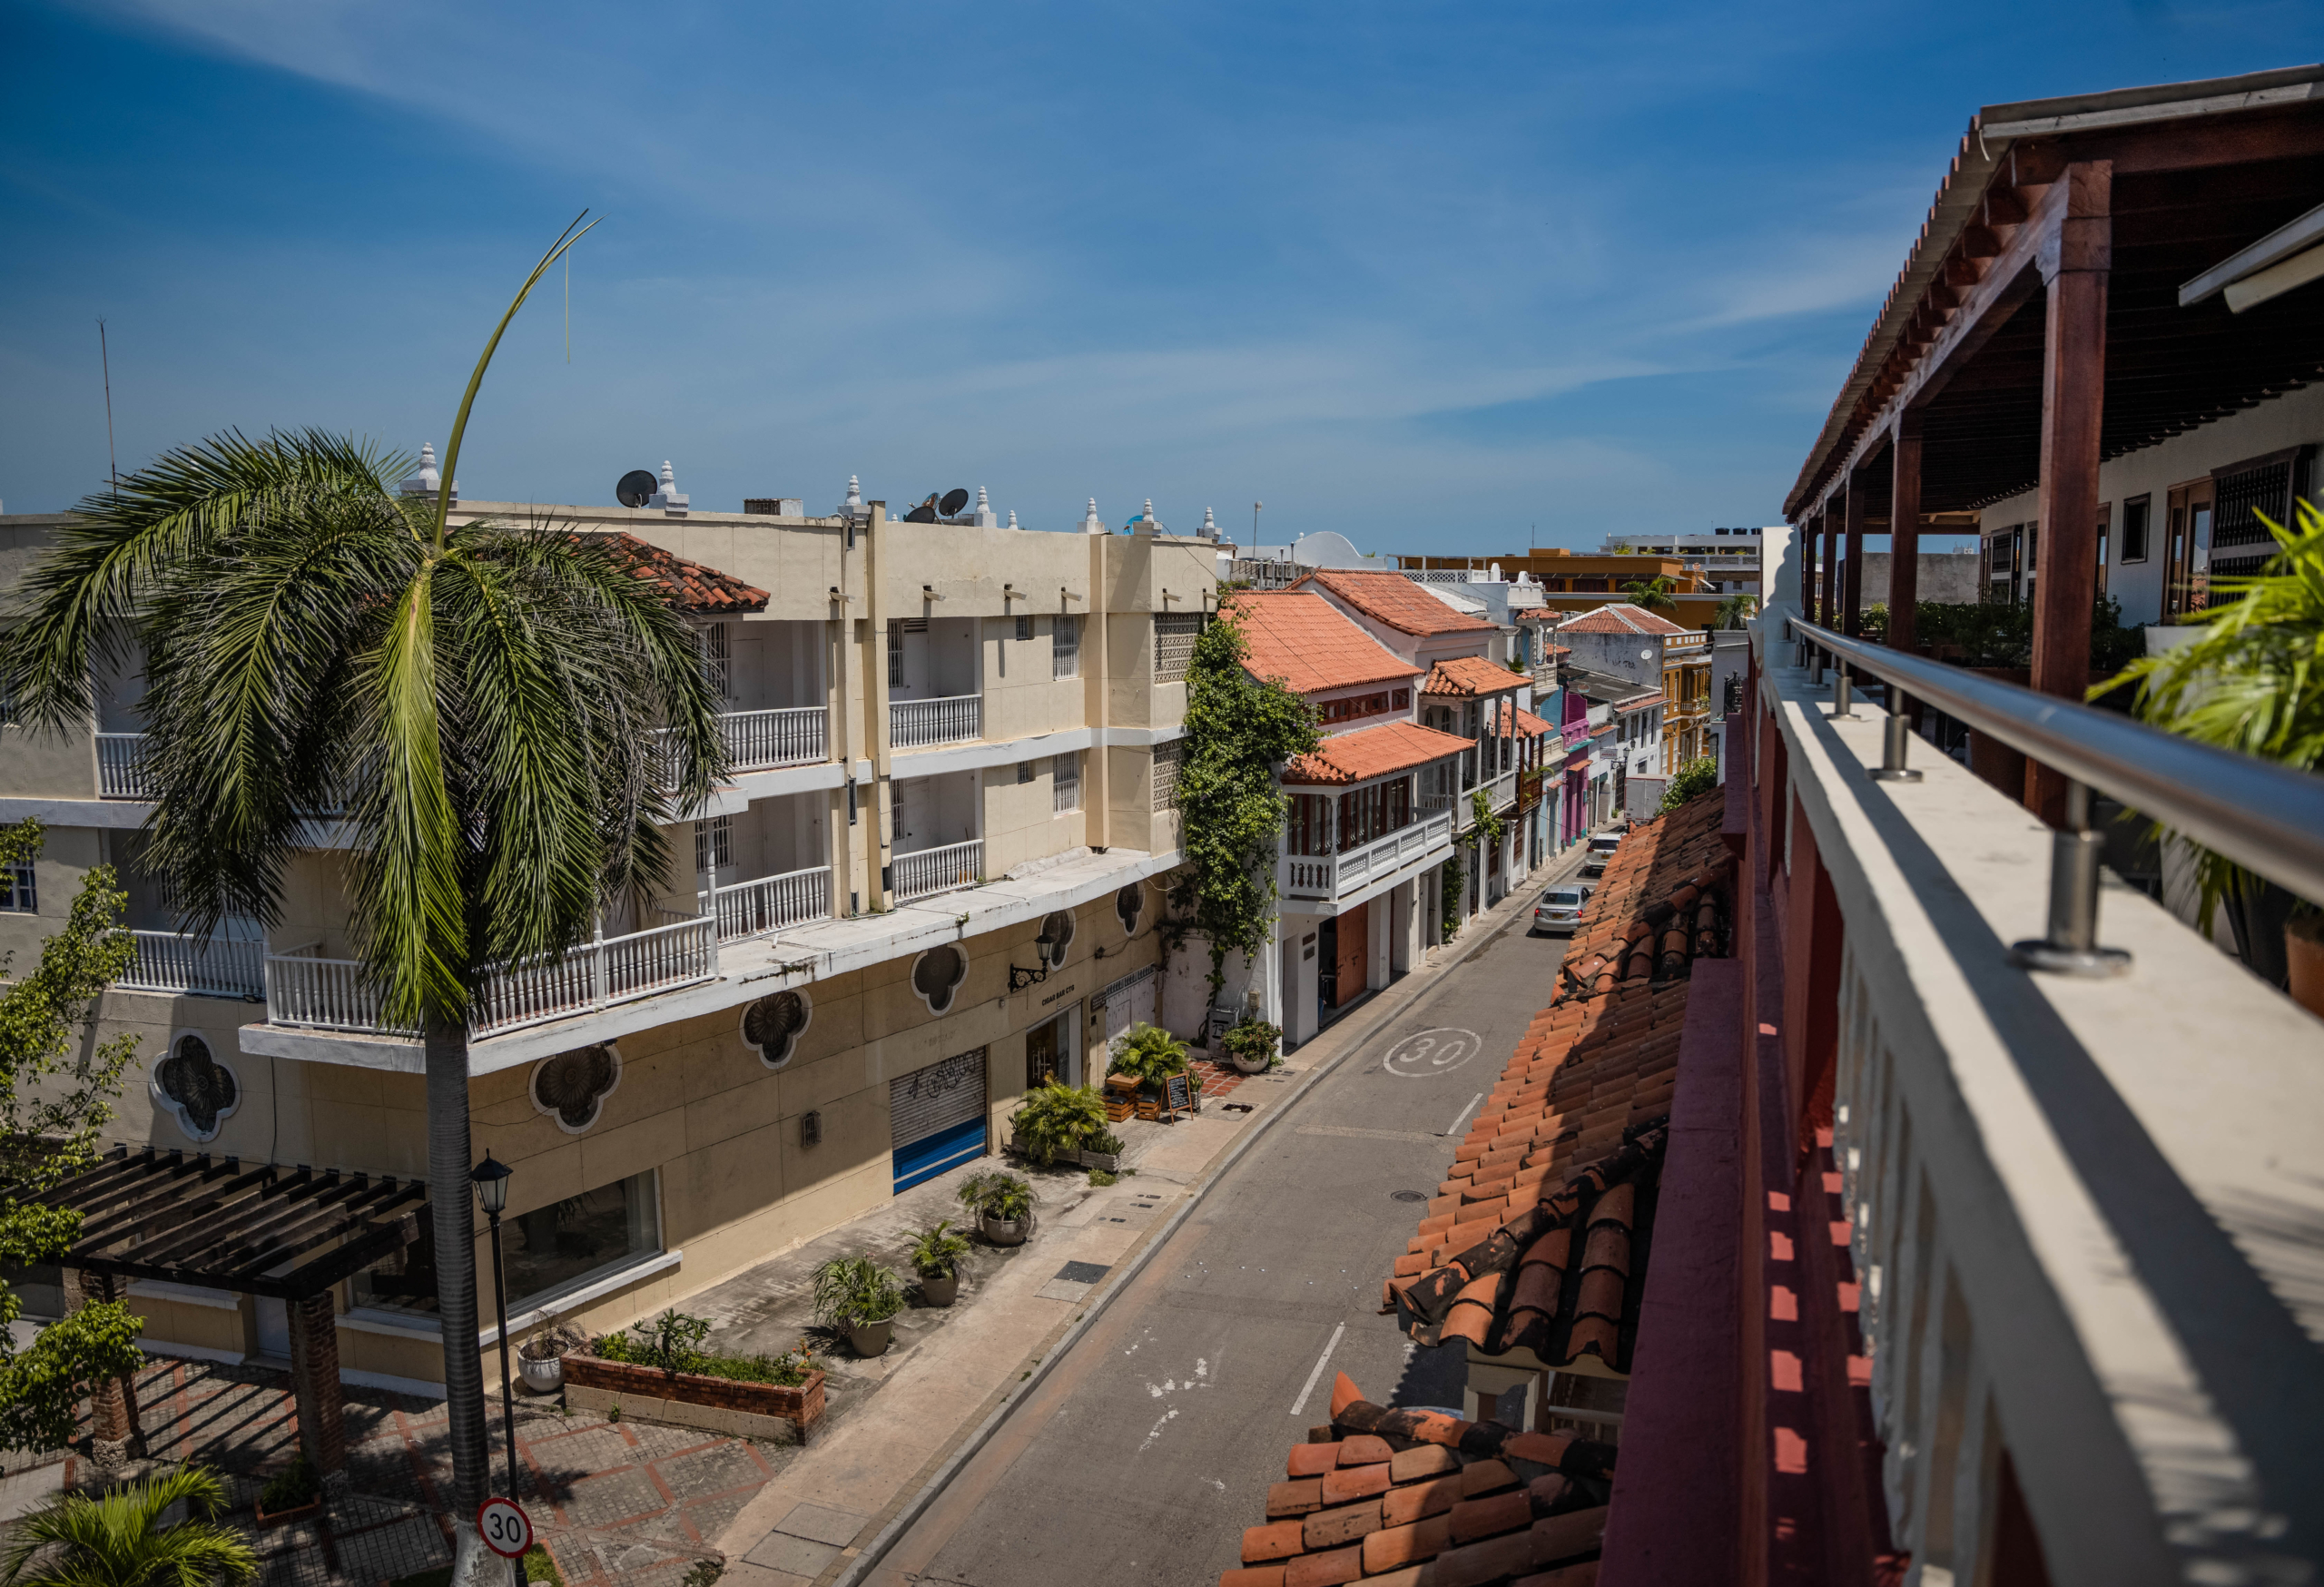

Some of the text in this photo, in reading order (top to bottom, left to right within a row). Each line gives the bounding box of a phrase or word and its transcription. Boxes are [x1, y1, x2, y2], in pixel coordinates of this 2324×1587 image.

[1041, 984, 1075, 1006] CIGAR BAR CTG
[1399, 1038, 1466, 1065] 30
[489, 1513, 521, 1543] 30
